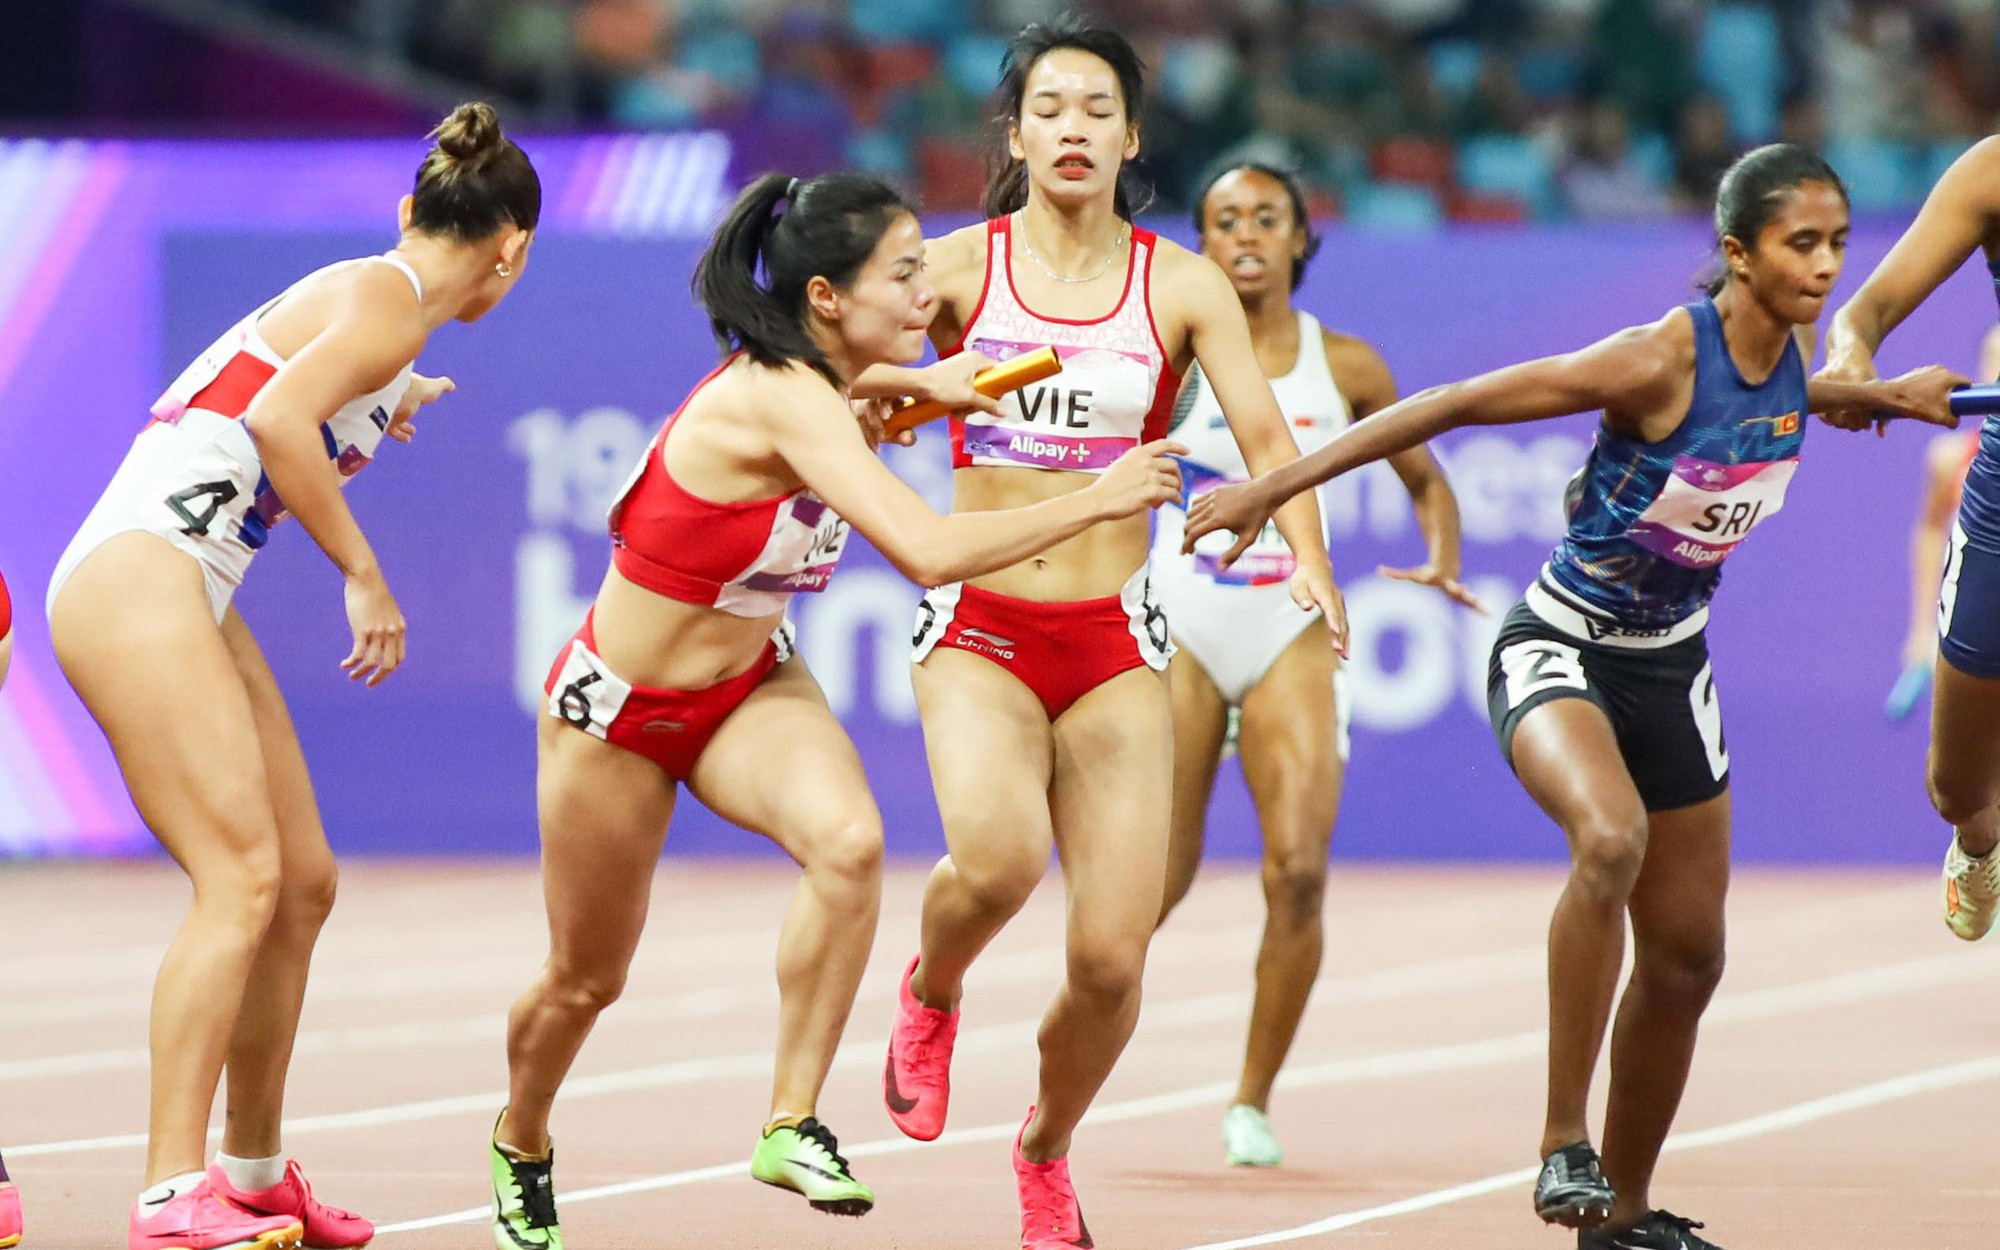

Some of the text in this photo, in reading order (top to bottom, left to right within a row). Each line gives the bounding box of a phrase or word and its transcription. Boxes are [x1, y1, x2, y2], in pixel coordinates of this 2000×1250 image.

[1016, 386, 1093, 428] VIE
[164, 479, 239, 537] 4
[1691, 499, 1763, 537] SRI
[955, 635, 1016, 661] LI-NING
[1522, 649, 1570, 690] 2
[558, 670, 602, 731] 6
